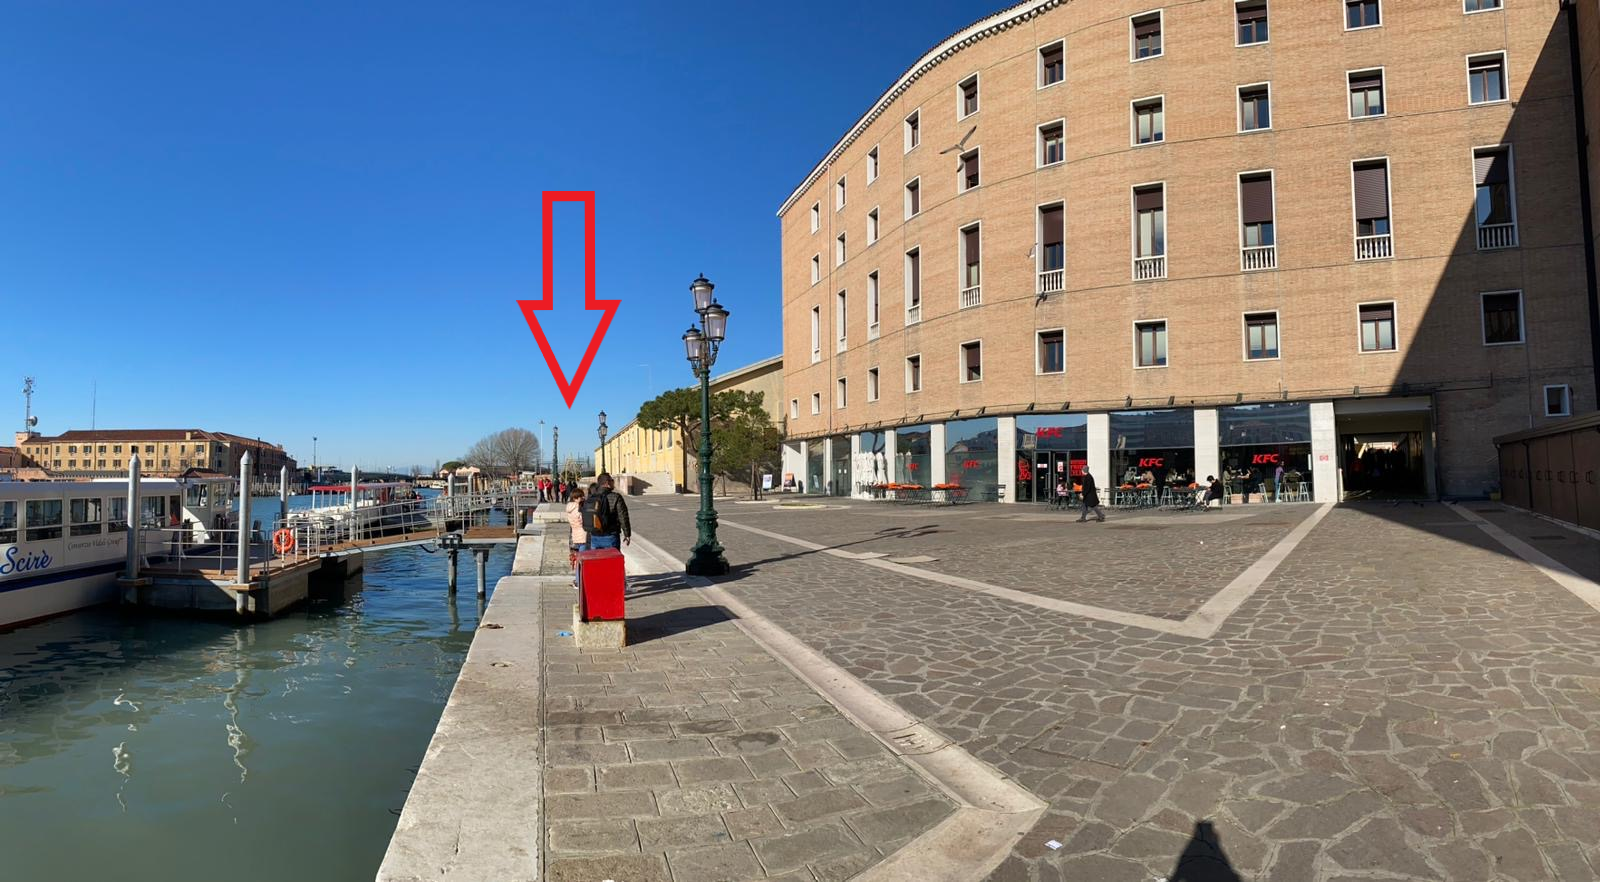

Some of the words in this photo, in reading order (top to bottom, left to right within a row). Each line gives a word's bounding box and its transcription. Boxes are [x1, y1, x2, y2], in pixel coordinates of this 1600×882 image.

[1036, 427, 1063, 438] KFC
[1138, 458, 1164, 467] KFC
[1252, 453, 1280, 464] KFC
[0, 546, 52, 575] Scirè
